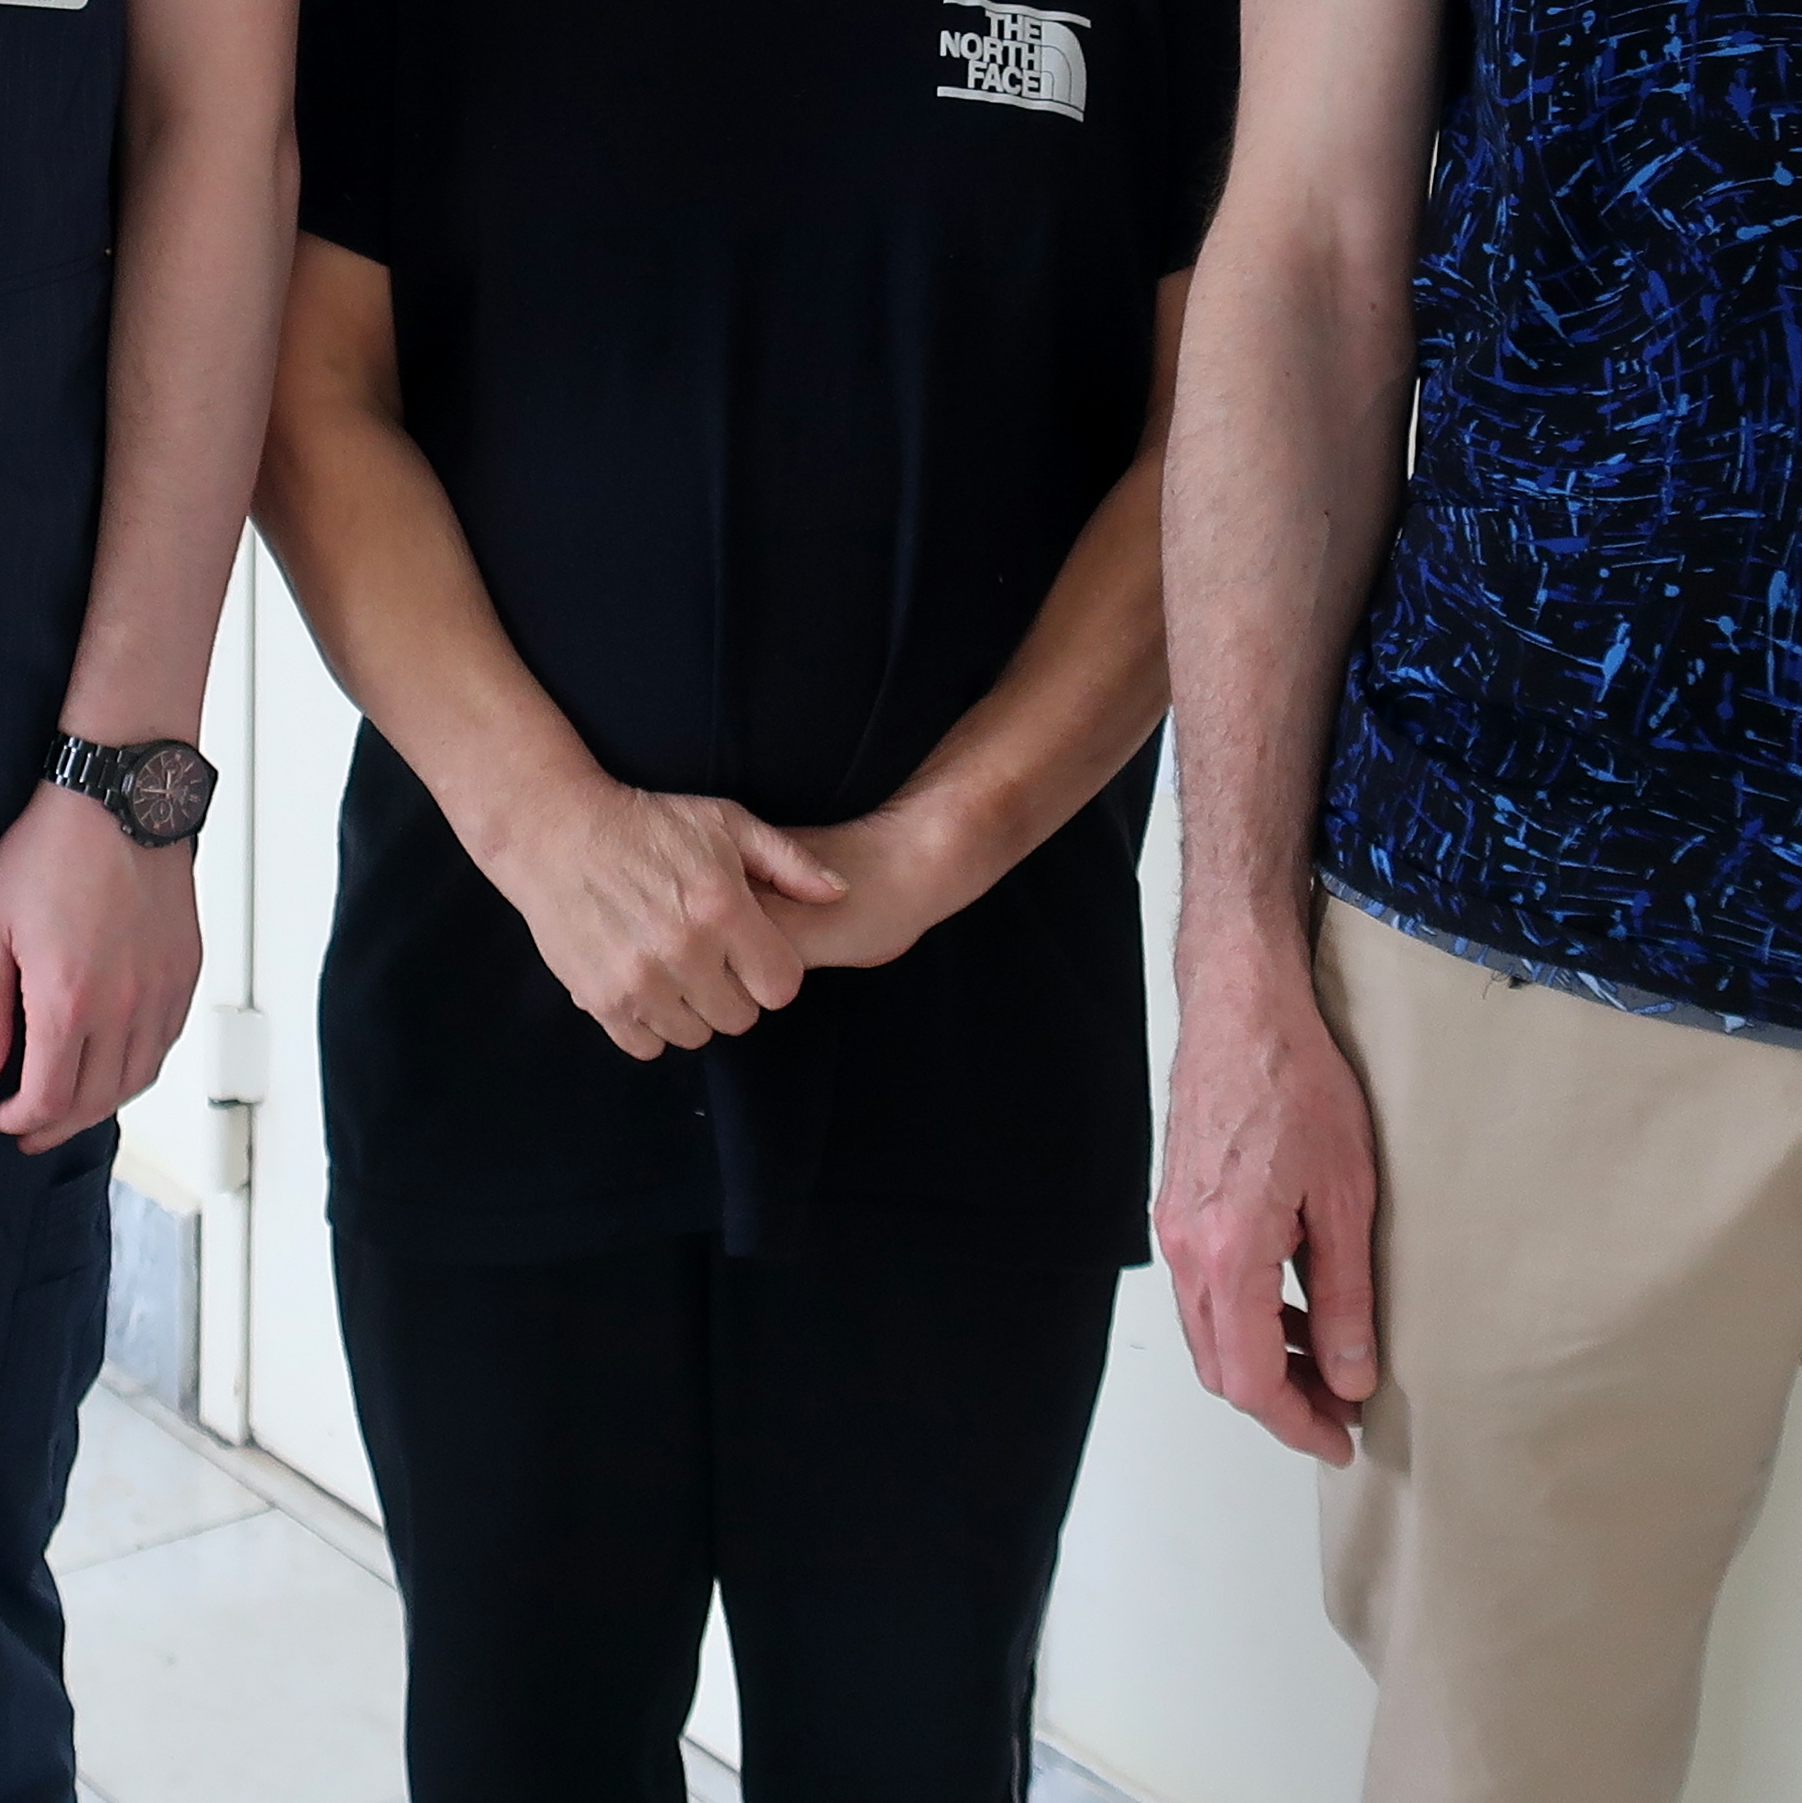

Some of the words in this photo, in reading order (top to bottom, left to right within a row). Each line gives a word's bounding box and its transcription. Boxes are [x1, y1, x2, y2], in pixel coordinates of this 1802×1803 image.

[985, 9, 1042, 45] THE
[939, 30, 1042, 72] NORTH
[967, 59, 1042, 98] FACE
